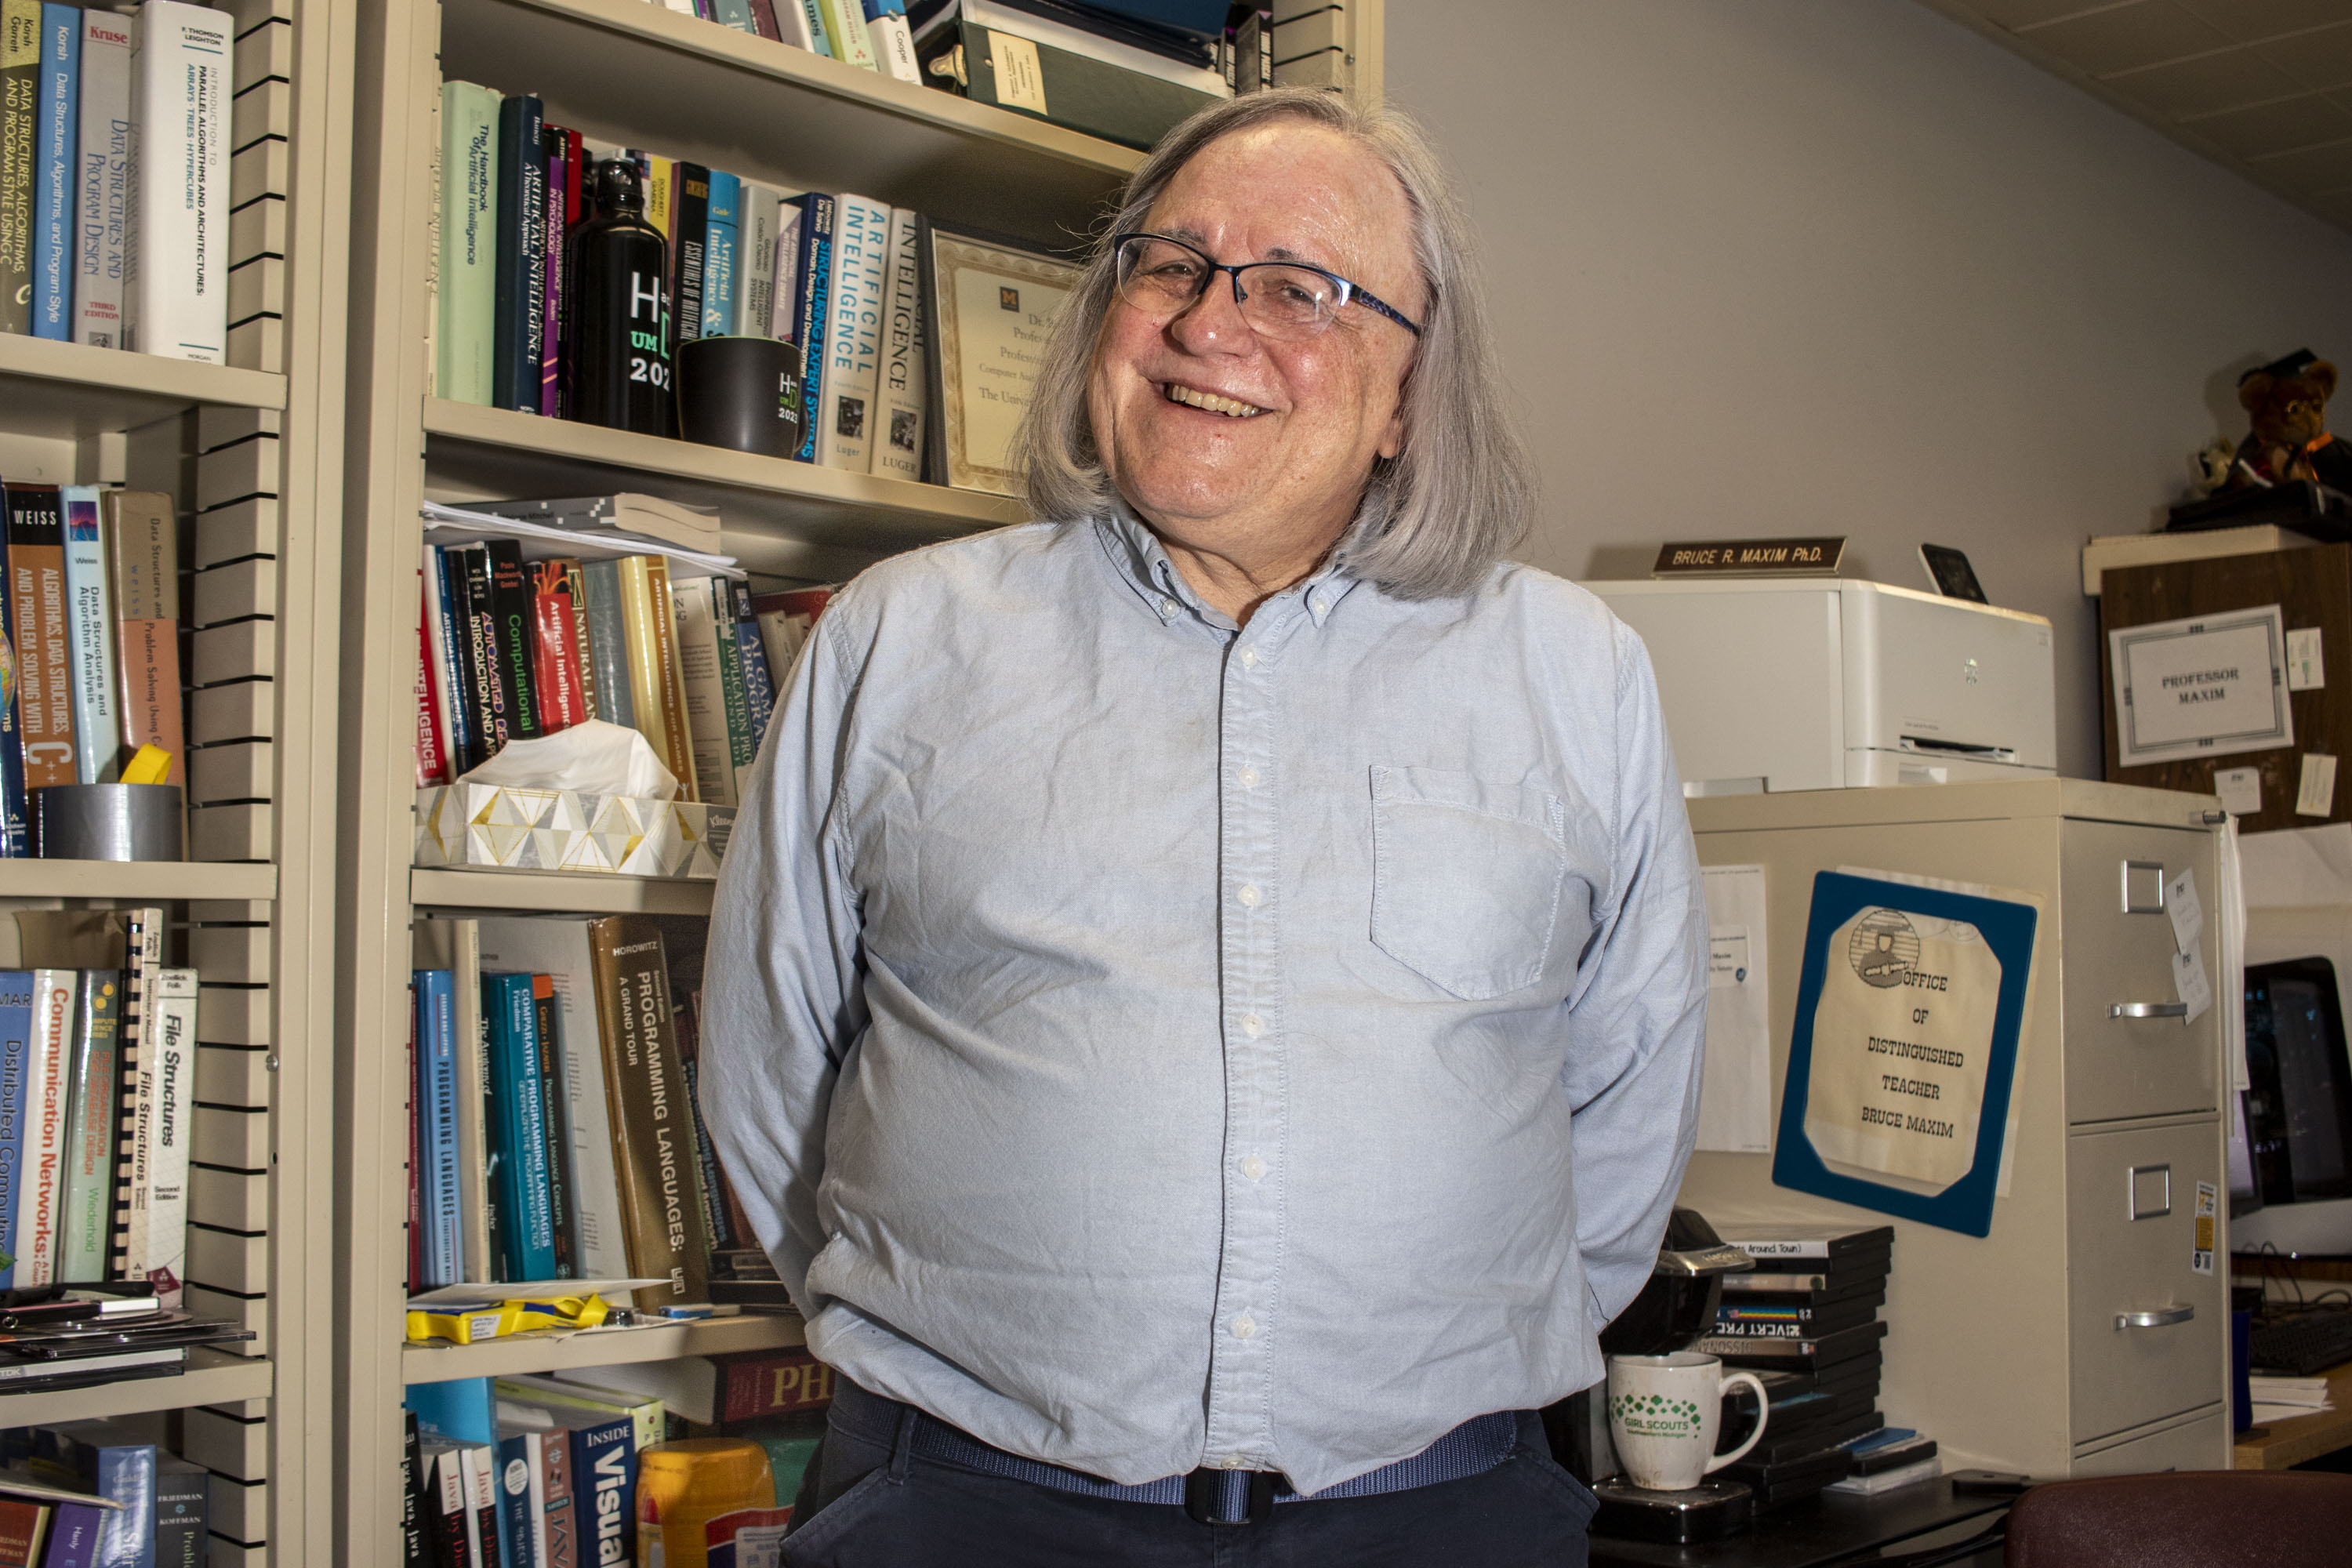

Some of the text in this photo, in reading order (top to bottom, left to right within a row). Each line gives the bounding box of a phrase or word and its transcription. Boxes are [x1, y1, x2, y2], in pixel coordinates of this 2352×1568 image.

[10, 16, 21, 53] Garrett
[23, 18, 34, 46] Korsh
[56, 26, 69, 60] Korsh
[89, 26, 129, 44] Kruse
[185, 34, 221, 45] LEIGHTON
[188, 27, 224, 39] THOMSON
[895, 30, 908, 64] Cooper
[187, 64, 195, 103] ARRAYS
[198, 66, 207, 114] PARALLEL
[209, 67, 218, 165] INTRODUCTION TO
[0, 77, 18, 253] AND PROGRAM STYLE USING
[12, 78, 32, 274] DATA STRUCTURES, ALGORITHMS,
[186, 143, 194, 209] HYPERCUBES
[198, 116, 207, 184] ALGORITHMS
[479, 125, 489, 212] The Handbook
[47, 73, 68, 323] Data Structures, Algorithms, and Program Style
[84, 153, 107, 276] PROGRAM DESIGN
[107, 119, 129, 279] DATA STRUCTURES AND
[466, 147, 480, 265] Artificial Intelligence
[523, 171, 532, 216] Theoretical
[196, 209, 205, 296] ARCHITECTURES:
[548, 200, 557, 255] PSYCHOLOGY
[527, 164, 543, 365] ARTIFICIAL INTELLIGENCE
[683, 241, 702, 287] ESSENTIALS
[706, 228, 722, 305] Intelligence
[719, 238, 732, 301] Artificial
[835, 205, 865, 370] INTELLIGENCE
[857, 210, 886, 373] ARTIFICIAL
[84, 310, 119, 320] EDITION
[89, 301, 116, 311] THIRD
[807, 241, 831, 395] STRUCTURING EXPERT
[888, 223, 916, 391] INTELLIGENCE
[631, 331, 658, 352] UM
[979, 363, 1017, 379] Computer
[979, 387, 999, 401] The
[837, 445, 860, 457] Luger
[883, 456, 916, 474] LUGER
[14, 510, 56, 525] WEISS
[150, 518, 163, 598] Data Structures
[1673, 547, 1823, 564] BRUCE R. MAXIM Ph.D.
[16, 568, 43, 734] AND PROBLEM SOLVING WITH
[42, 568, 70, 735] ALGORITHMS, DATA STRUCTURES,
[78, 586, 96, 704] Algorithm Analysis
[90, 586, 107, 716] Data Structures and
[550, 601, 564, 656] Artificial
[575, 613, 592, 688] NATURAL
[144, 622, 162, 732] Problem Solving Using
[470, 615, 490, 704] INTRODUCTION
[481, 705, 494, 734] AND
[481, 612, 505, 713] AUTOMATED
[509, 615, 534, 731] Computational
[655, 578, 684, 772] ARTIFICIAL INTELLIGENCE GAMES
[728, 646, 747, 724] APPLICATION
[2162, 669, 2239, 689] PROFESSOR
[2179, 687, 2225, 705] MAXIM
[613, 941, 658, 956] HOROWITZ
[512, 990, 521, 1033] Friedman
[1903, 971, 1948, 992] OFFICE
[619, 977, 638, 1066] A GRAND TOUR
[1912, 1008, 1929, 1025] OF
[161, 1014, 182, 1148] File Structures
[1867, 1036, 1964, 1067] DISTINGUISHED
[1, 1040, 22, 1140] Distributed
[521, 989, 550, 1247] COMPARATIVE PROGRAMMING LANGUAGES
[637, 971, 684, 1252] PROGRAMMING LANGUAGES:
[1882, 1075, 1940, 1099] TEACHER
[34, 988, 69, 1259] Communication Networks:
[136, 1072, 152, 1181] File Structures
[437, 1062, 455, 1215] PROGRAMMING LANGUAGES
[1861, 1106, 1954, 1138] BRUCE MAXIM
[85, 1187, 100, 1253] Wiederhold
[1748, 1243, 1802, 1253] Around Town)
[587, 1427, 630, 1448] INSIDE
[1625, 1417, 1689, 1430] GIRL SCOUTS
[158, 1494, 203, 1503] FRIEDMAN
[401, 1457, 419, 1559] Java, Java, Java
[447, 1473, 463, 1534] Java by
[478, 1471, 492, 1504] Java
[514, 1501, 524, 1521] THE
[594, 1445, 628, 1568] Visual
[70, 1526, 83, 1550] Hanly
[159, 1516, 201, 1526] KOFFMAN
[514, 1526, 527, 1565] OBJECT
